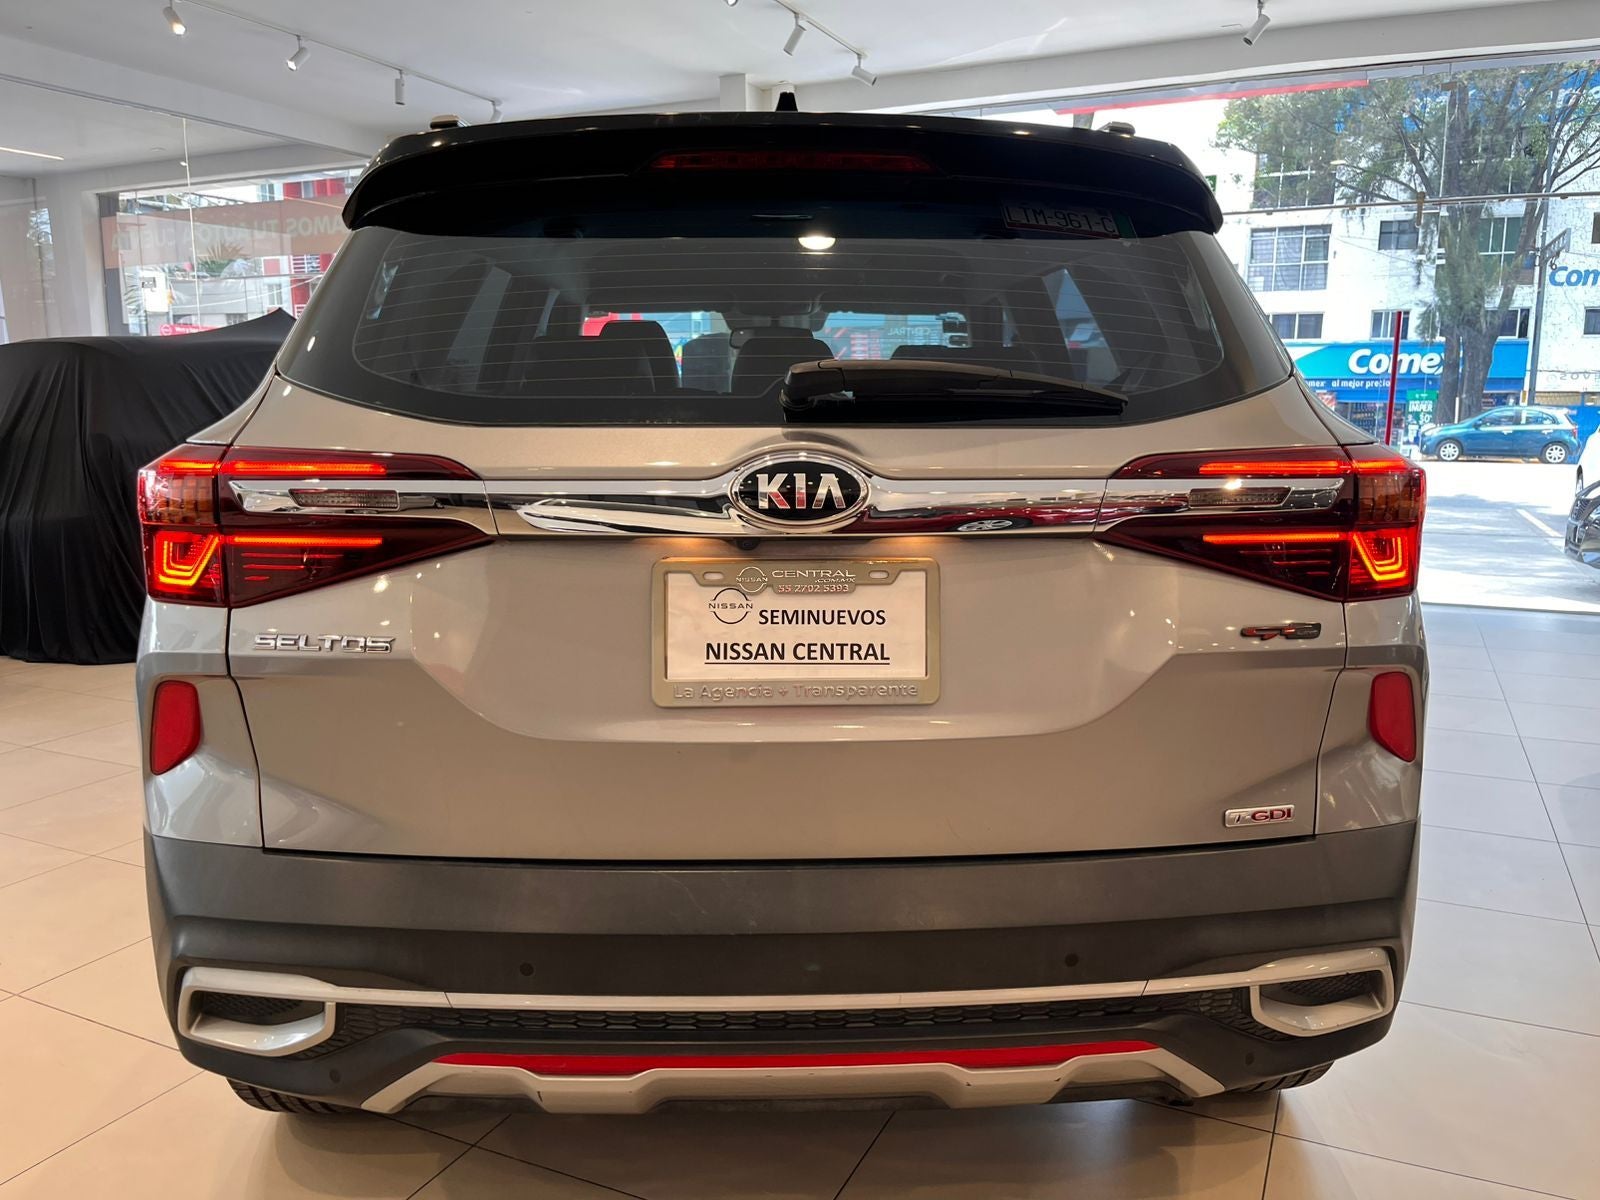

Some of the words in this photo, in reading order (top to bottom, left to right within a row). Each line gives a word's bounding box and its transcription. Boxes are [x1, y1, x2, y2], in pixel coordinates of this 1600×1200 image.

[1341, 380, 1364, 389] mejor
[756, 473, 846, 509] KIA
[772, 569, 856, 578] CENTRAL
[778, 585, 792, 593] 55
[795, 585, 821, 593] 2702
[758, 610, 886, 625] SEMINUEVOS
[254, 633, 396, 654] SELTOS
[706, 642, 785, 661] NISSAN
[793, 643, 890, 661] CENTRAL
[673, 685, 694, 698] La
[700, 685, 774, 702] Agencia
[794, 683, 919, 700] Transparente
[1230, 808, 1293, 824] T-GDI
